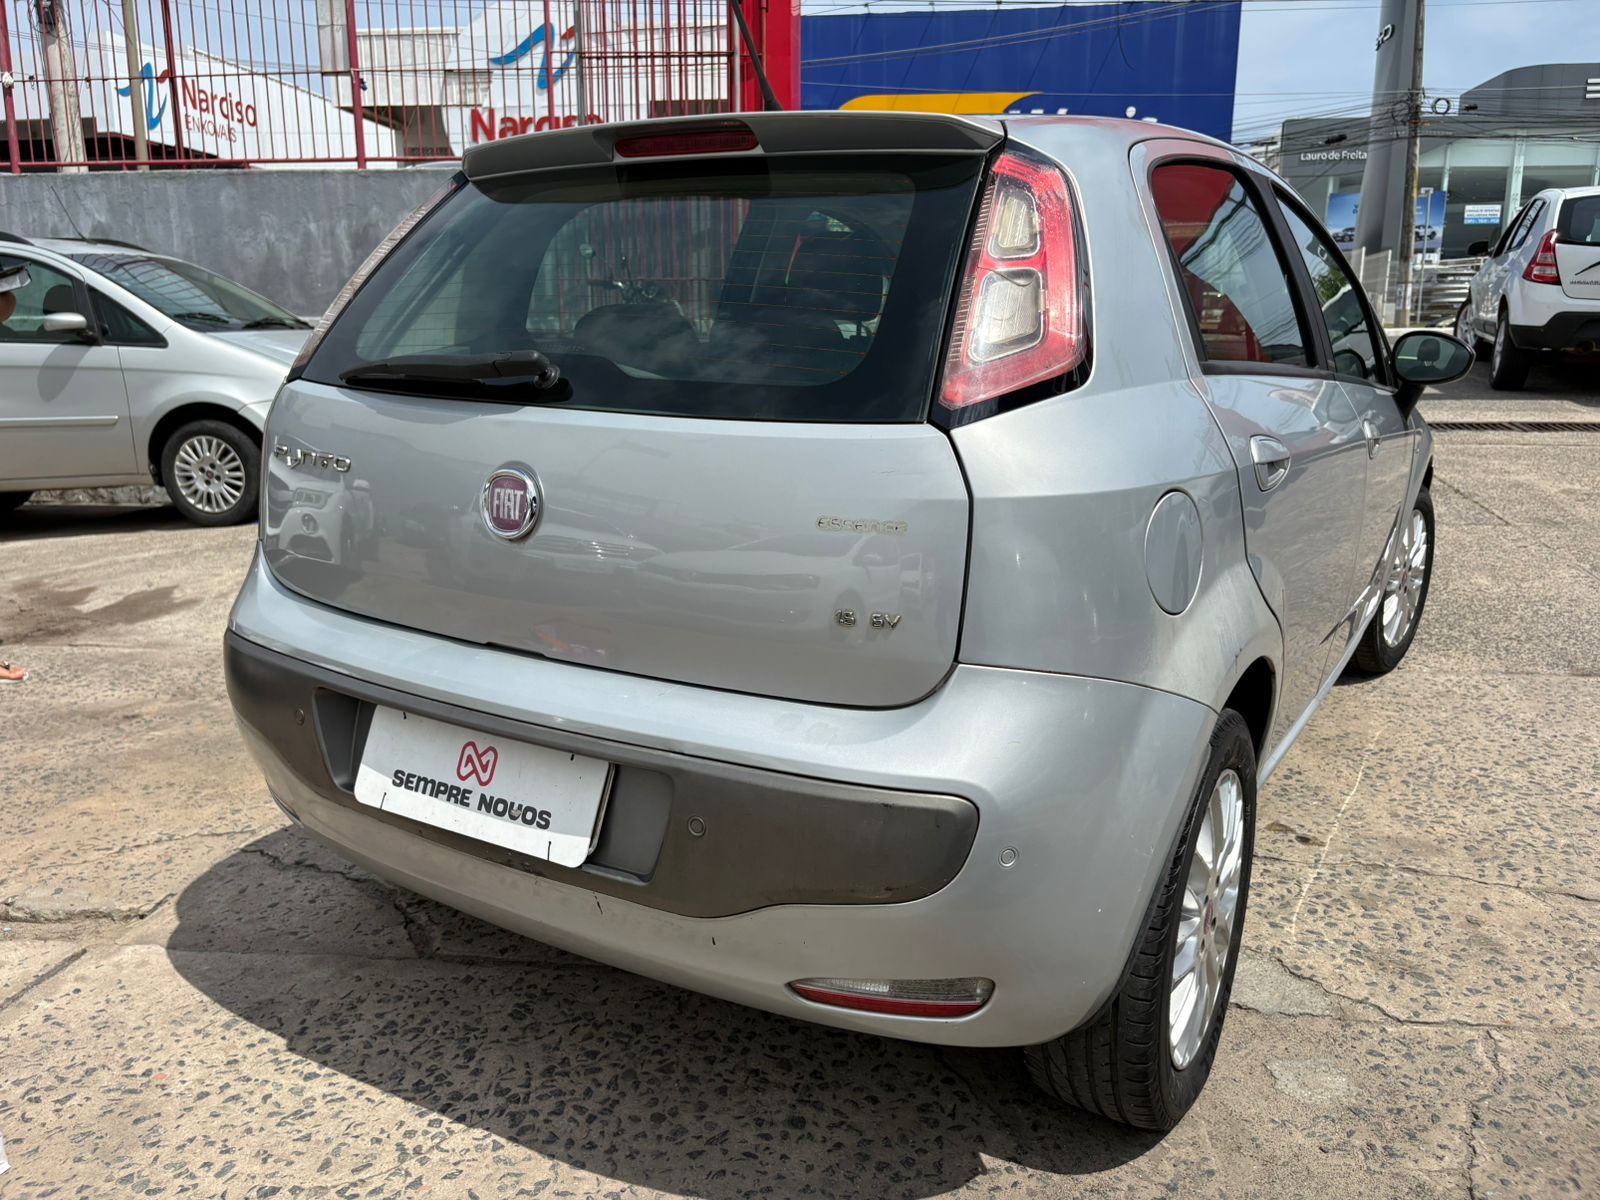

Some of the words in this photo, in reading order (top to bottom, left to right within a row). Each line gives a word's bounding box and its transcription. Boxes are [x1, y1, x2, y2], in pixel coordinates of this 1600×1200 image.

[182, 75, 257, 127] Narciso
[1301, 151, 1327, 161] Lauro
[1328, 150, 1340, 160] de
[275, 444, 351, 474] PUNTO
[492, 487, 524, 521] FIAT
[391, 769, 473, 807] SEMPRE
